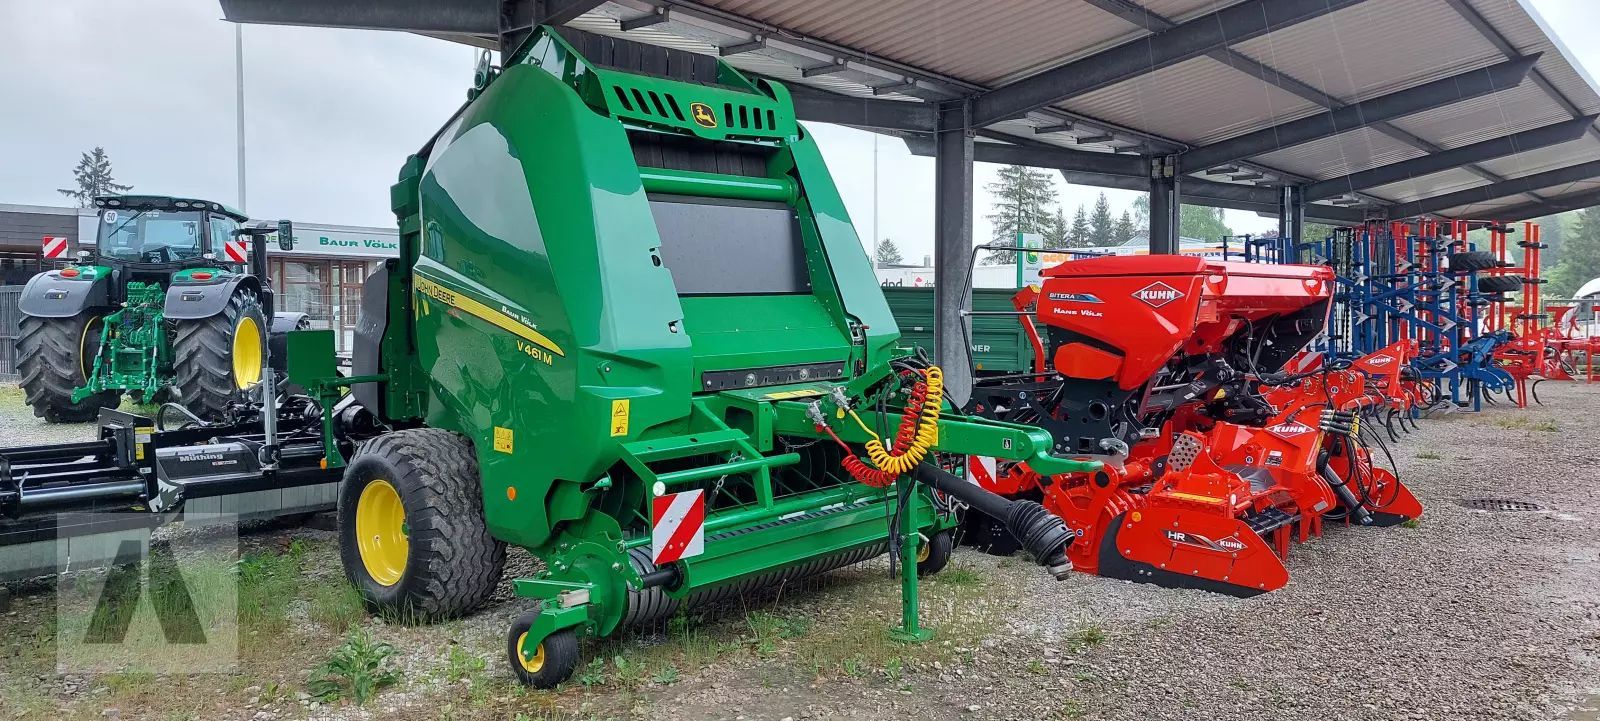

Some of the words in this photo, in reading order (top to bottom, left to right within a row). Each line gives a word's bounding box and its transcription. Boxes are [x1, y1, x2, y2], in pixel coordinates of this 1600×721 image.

[106, 212, 116, 224] 50
[319, 236, 359, 247] BAUR
[363, 239, 398, 249] VÖLK
[433, 284, 456, 305] DEERE
[1049, 292, 1075, 300] BITERA
[1140, 290, 1176, 300] KUHN
[516, 339, 524, 352] V
[524, 344, 542, 361] 461
[543, 351, 553, 366] M
[1368, 356, 1392, 365] KUHN
[1273, 425, 1307, 434] KUHN
[179, 453, 224, 462] Müthing
[1168, 530, 1186, 542] HR
[1220, 540, 1242, 549] KUHN
